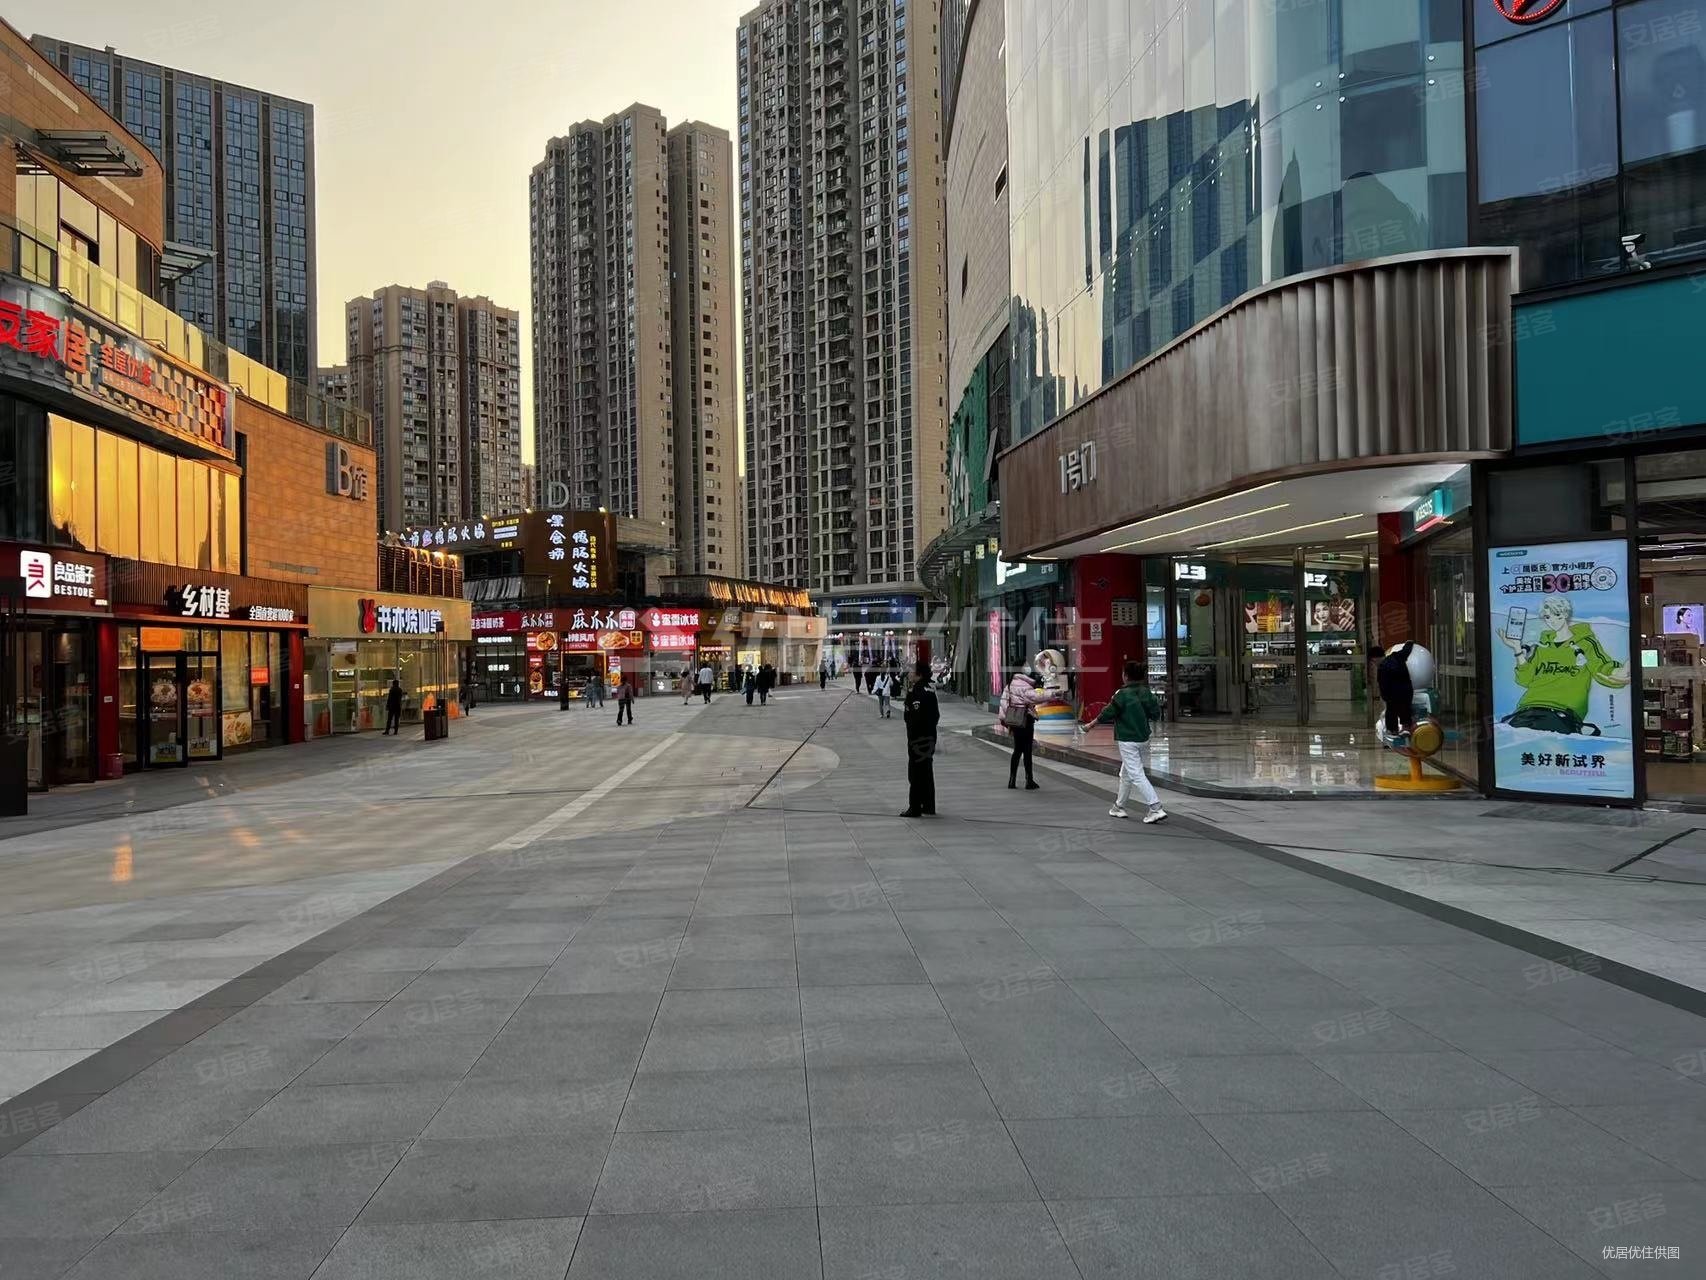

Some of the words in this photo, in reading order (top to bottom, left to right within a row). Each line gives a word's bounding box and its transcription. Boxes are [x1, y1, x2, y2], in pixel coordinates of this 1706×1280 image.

[1058, 440, 1097, 494] 1号门
[54, 562, 95, 585] 良品铺子
[1552, 562, 1595, 571] 官方小程序
[54, 585, 95, 598] BESTORE
[182, 584, 231, 619] 乡村基
[571, 608, 619, 630] 麻爪爪
[661, 613, 699, 626] 蜜雪冰城
[660, 634, 696, 647] 蜜雪冰城
[1520, 752, 1606, 768] 美好新试界
